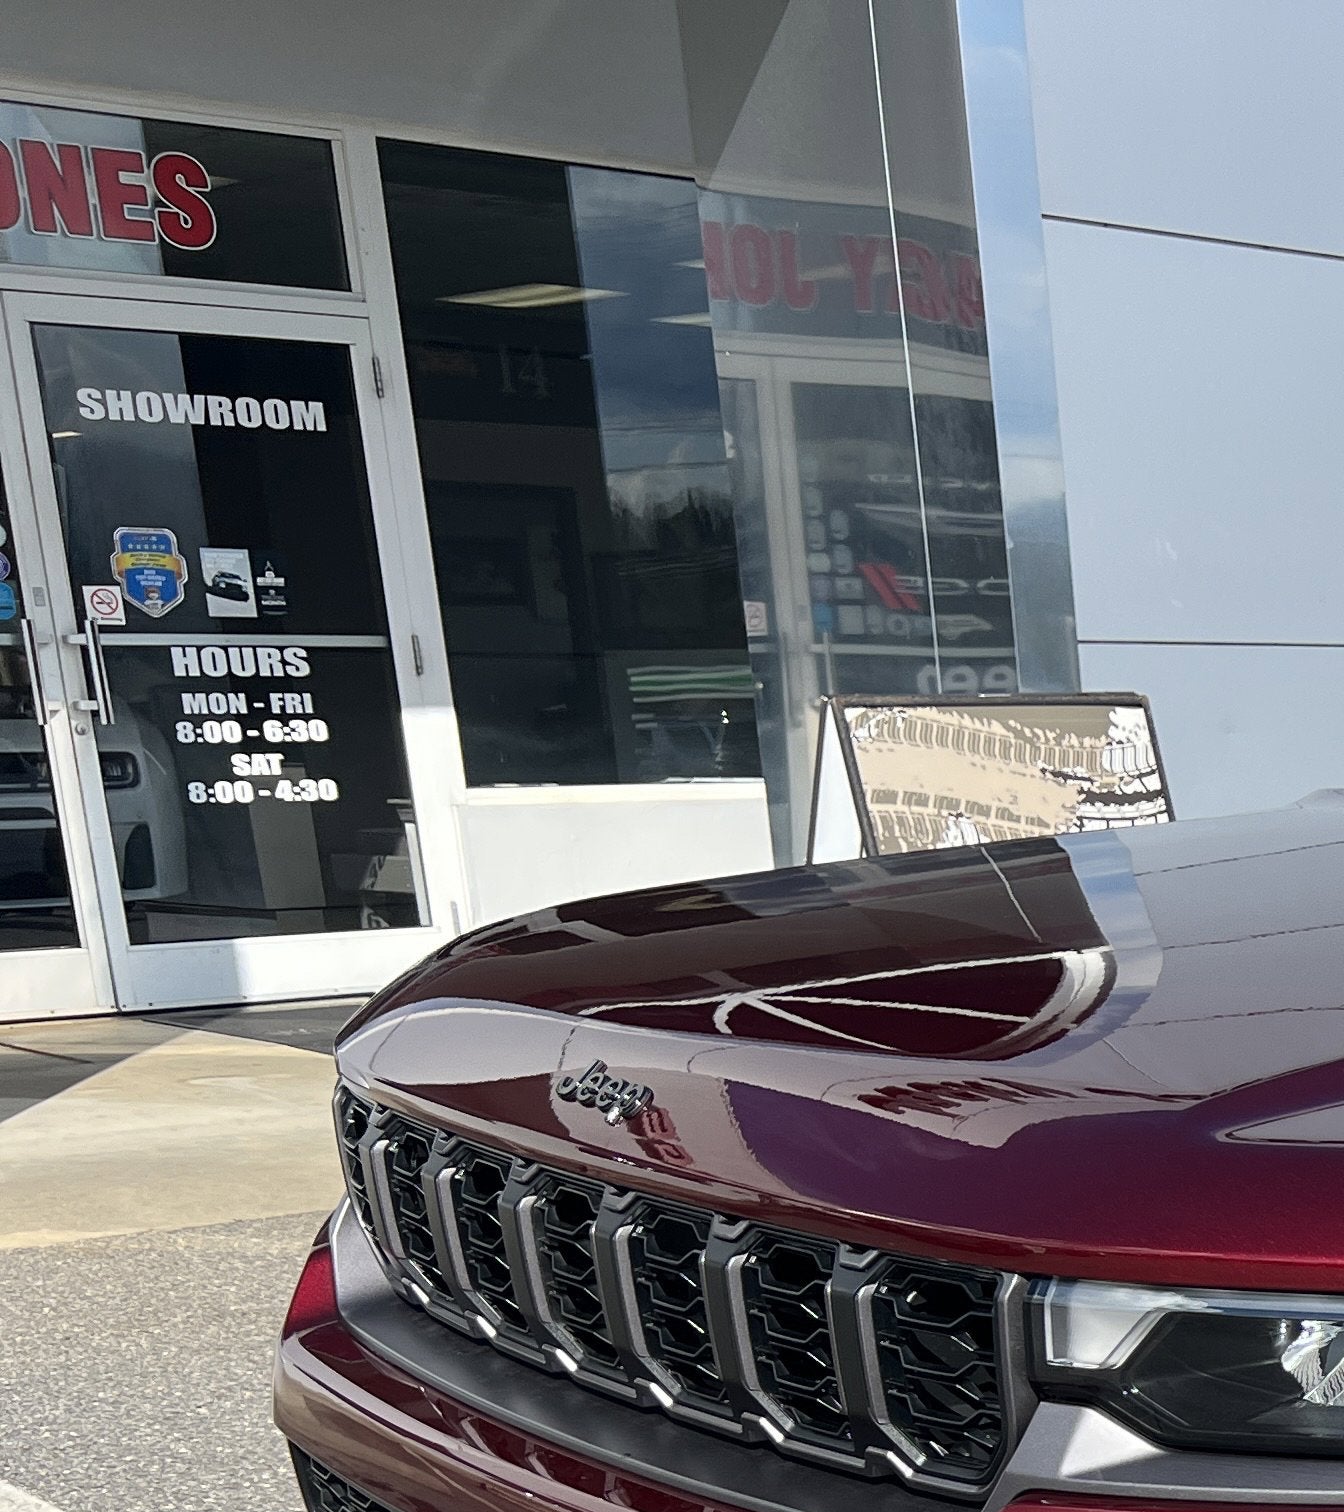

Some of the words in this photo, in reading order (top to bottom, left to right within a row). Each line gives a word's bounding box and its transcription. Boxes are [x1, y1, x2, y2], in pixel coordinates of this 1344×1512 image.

[76, 387, 327, 432] SHOWROOM
[170, 646, 311, 677] HOURS
[181, 693, 248, 715] MON
[269, 693, 315, 714] FRI
[175, 720, 243, 743] 8:00
[262, 719, 330, 743] 6:30
[230, 753, 285, 777] SAT
[187, 780, 255, 804] 8:00
[274, 778, 339, 802] 4:30
[556, 1059, 655, 1127] Jeep
